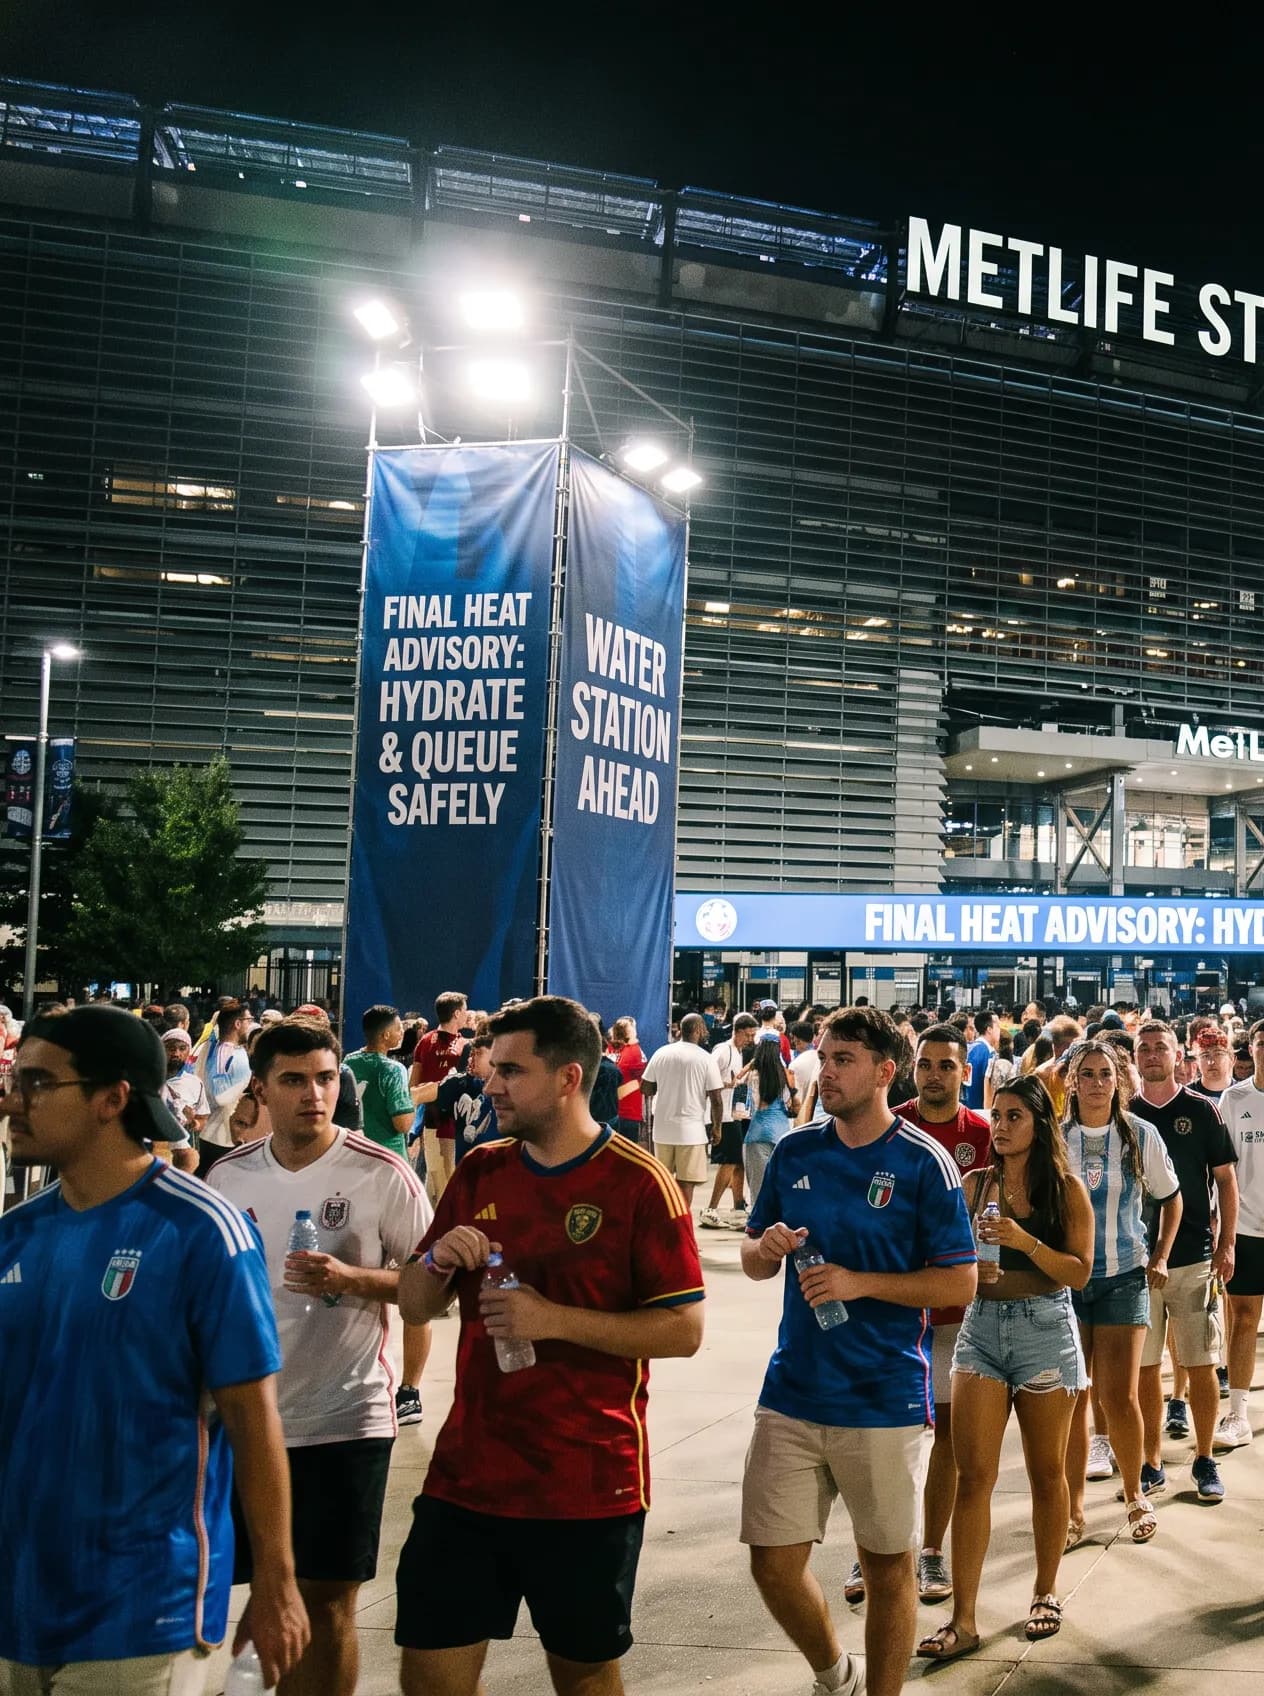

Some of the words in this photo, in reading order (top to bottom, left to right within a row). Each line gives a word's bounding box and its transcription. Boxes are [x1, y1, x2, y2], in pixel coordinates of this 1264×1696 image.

[907, 216, 1174, 345] METLIFE
[383, 594, 457, 629] FINAL
[464, 592, 533, 627] HEAT
[383, 634, 524, 672] ADVISORY:
[585, 612, 666, 698] WATER
[380, 679, 525, 722] HYDRATE
[570, 681, 671, 764] STATION
[379, 731, 403, 773] &
[411, 730, 519, 780] QUEUE
[387, 782, 506, 826] SAFELY
[577, 755, 660, 825] AHEAD
[865, 903, 954, 942] FINAL
[961, 905, 1038, 943] HEAT
[1044, 905, 1205, 944] ADVISORY:
